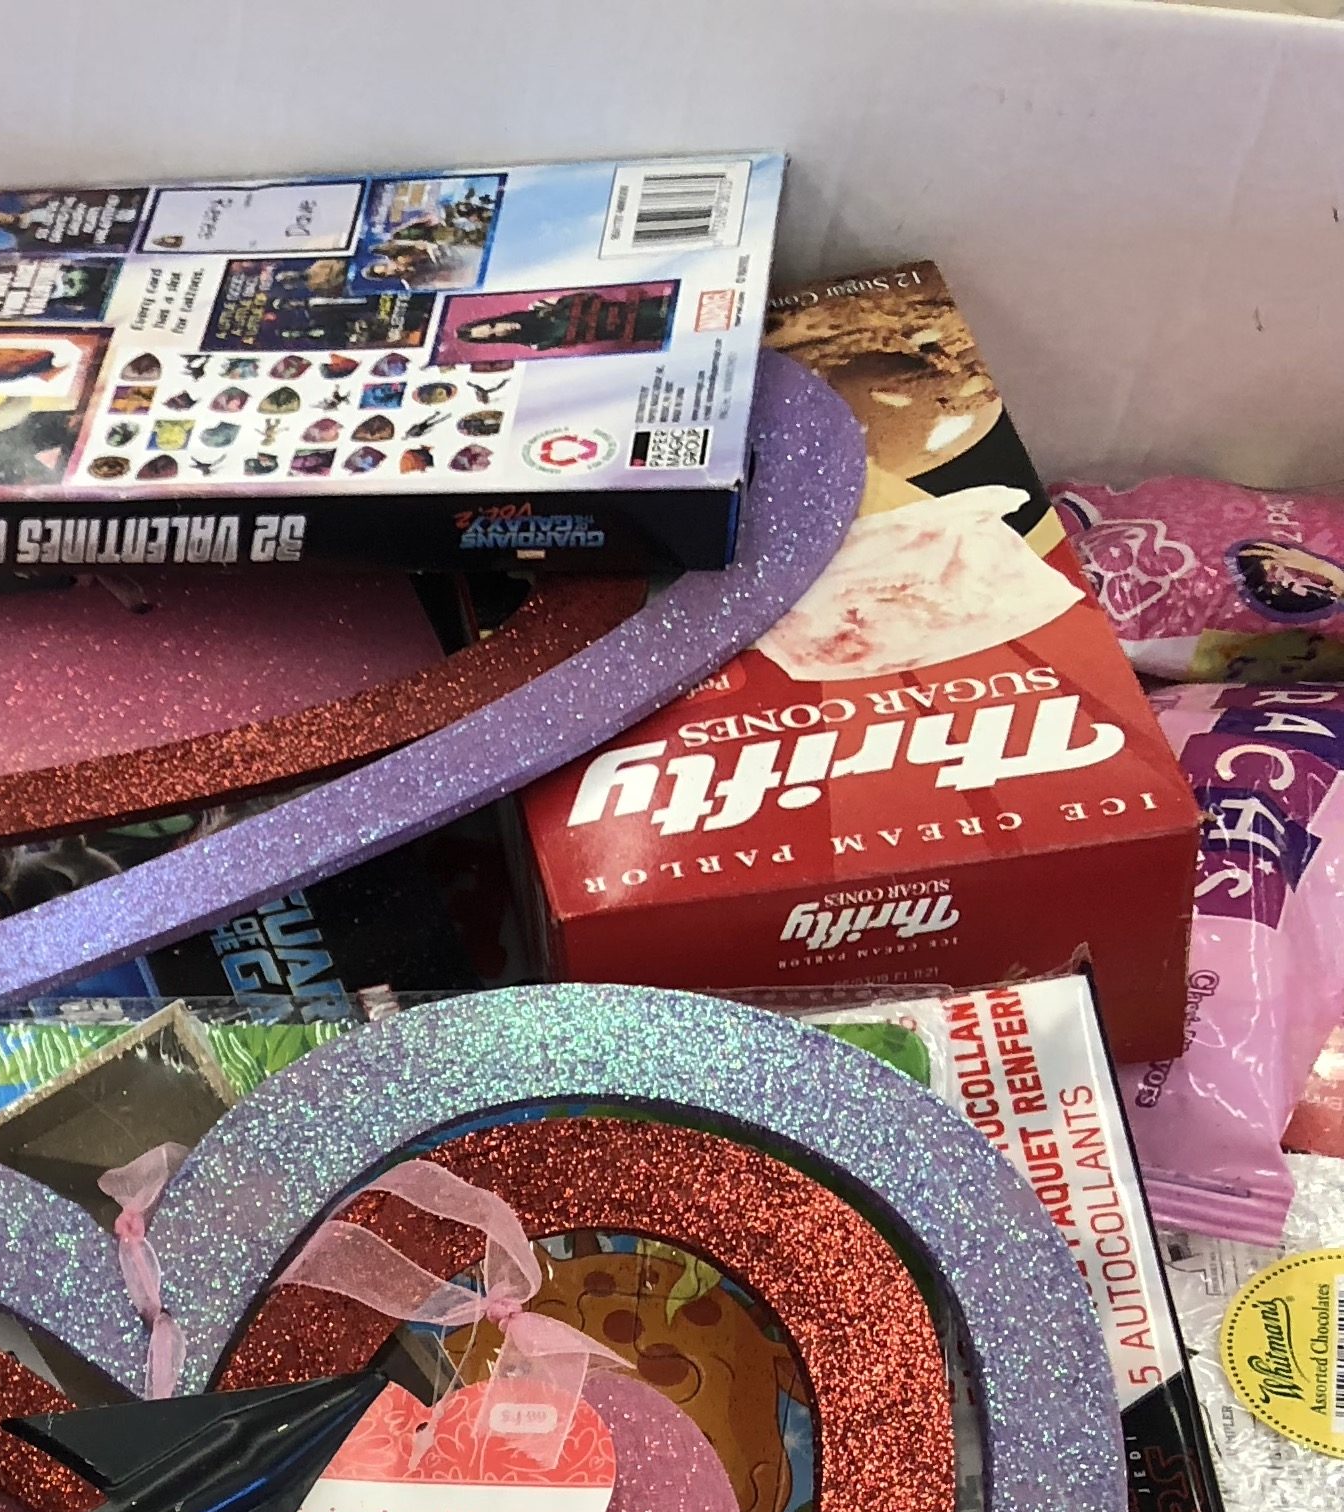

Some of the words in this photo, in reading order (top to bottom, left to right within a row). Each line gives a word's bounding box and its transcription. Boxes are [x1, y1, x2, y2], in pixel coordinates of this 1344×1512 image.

[825, 275, 890, 298] Sugar
[894, 270, 922, 288] 12
[649, 430, 667, 467] PAPER
[667, 429, 685, 467] MAGIC
[683, 428, 701, 466] GROUP
[17, 516, 239, 563] VALENTINES
[250, 515, 306, 562] 32
[459, 531, 605, 549] GUARDIANS
[468, 516, 574, 534] GALAXY
[868, 666, 1061, 715] SUGAR
[676, 697, 855, 749] CONES
[566, 693, 1126, 837] Thrifty
[1058, 792, 1158, 824] ICE
[829, 810, 1023, 857] CREAM
[581, 844, 795, 896] PARLOR
[822, 885, 885, 908] CONES
[887, 878, 951, 903] SUGAR
[232, 916, 266, 948] OF
[778, 894, 961, 951] Thrifty
[775, 950, 847, 970] PARLOR
[856, 942, 918, 959] CREAM
[928, 936, 959, 954] ICE
[1060, 1085, 1156, 1352] AUTOCOLLANTS
[1311, 1284, 1329, 1354] Chocolates
[1251, 1298, 1309, 1402] Whitman's
[1130, 1361, 1161, 1386] 5
[1311, 1356, 1326, 1415] Assorted
[1126, 1435, 1150, 1493] JEDI
